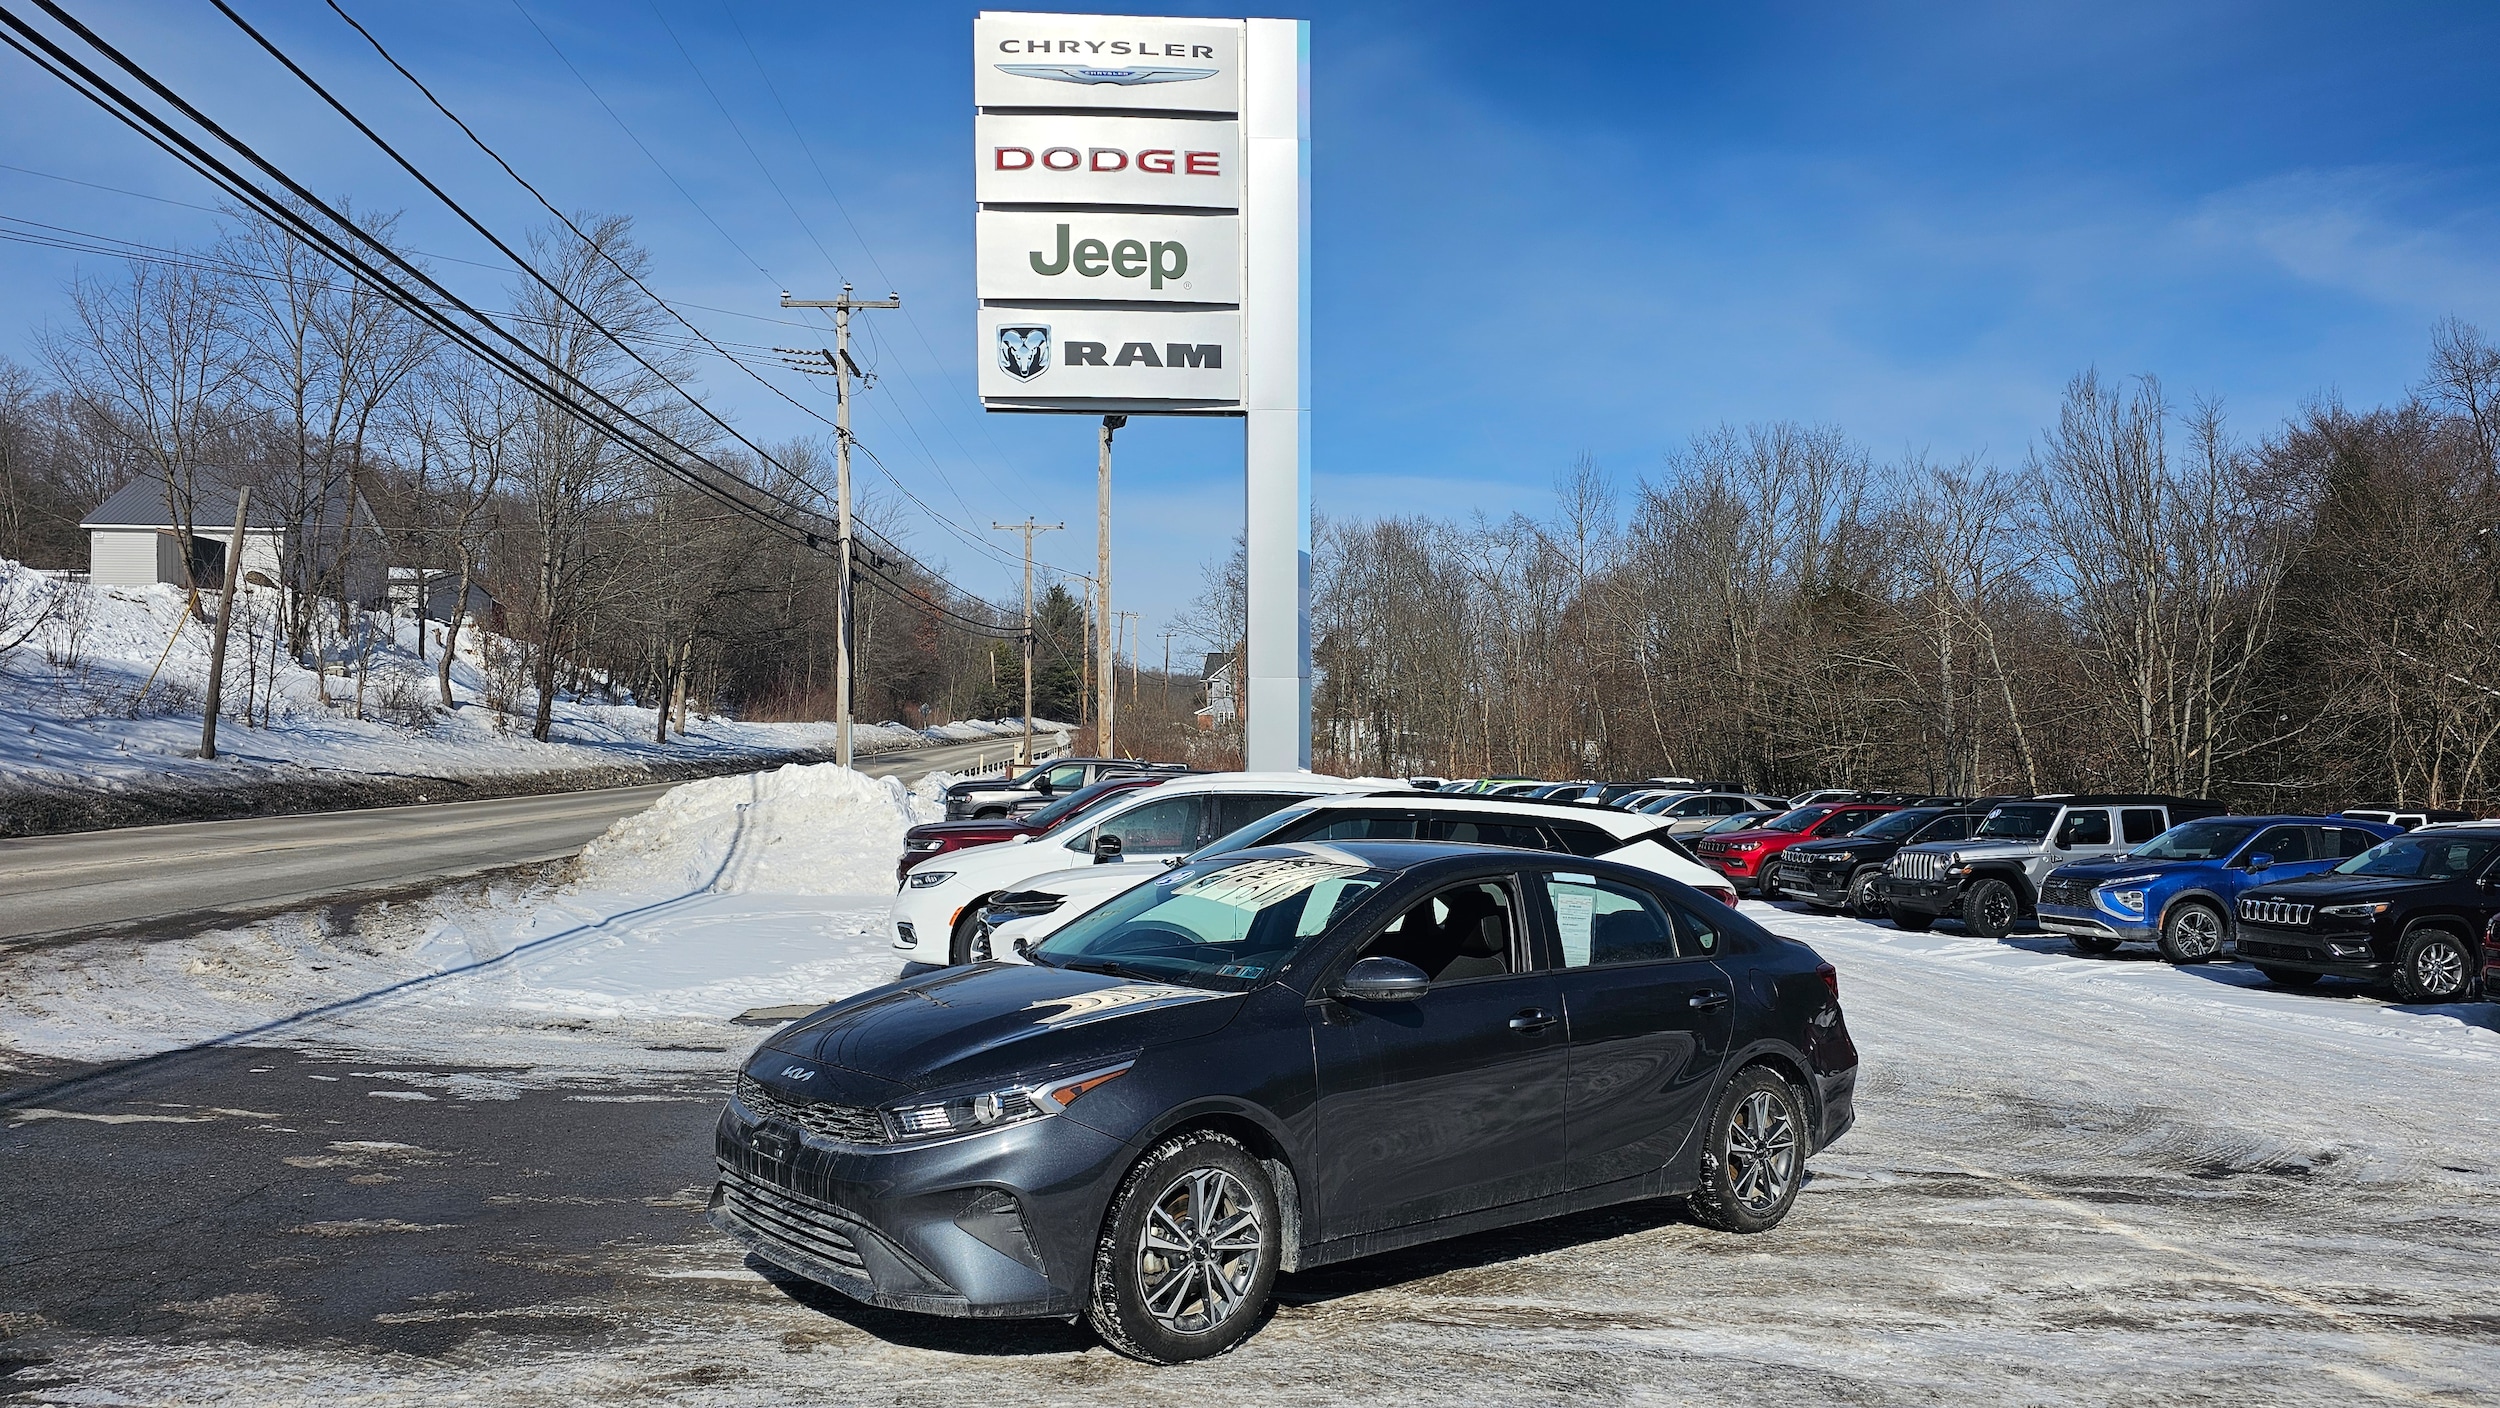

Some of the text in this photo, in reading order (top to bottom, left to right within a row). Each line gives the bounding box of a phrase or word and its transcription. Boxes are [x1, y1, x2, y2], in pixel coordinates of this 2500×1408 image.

[999, 39, 1214, 59] CHRYSLER
[995, 146, 1221, 177] DODGE
[1029, 223, 1188, 290] Jeep
[1064, 341, 1222, 369] RAM
